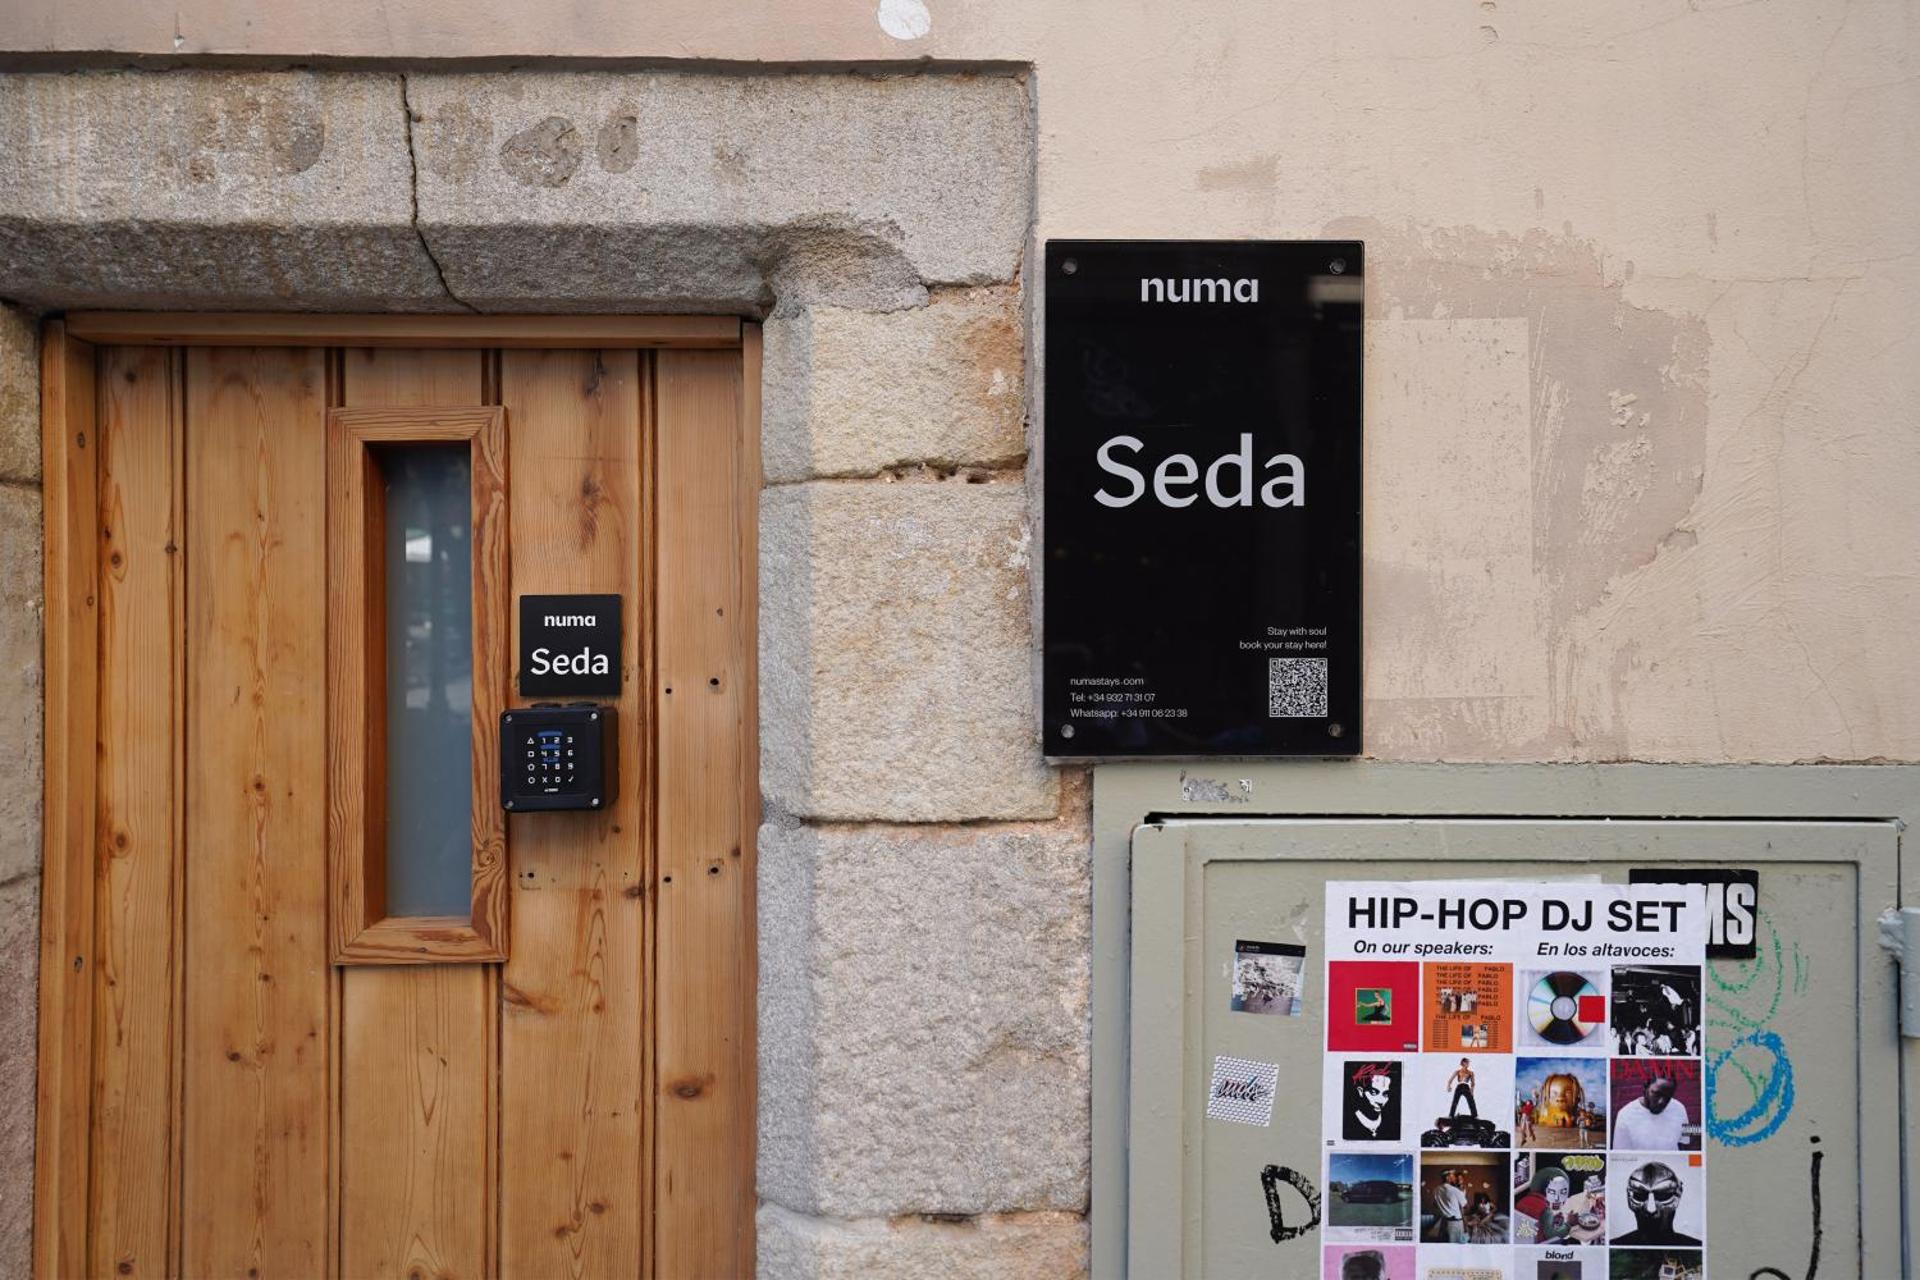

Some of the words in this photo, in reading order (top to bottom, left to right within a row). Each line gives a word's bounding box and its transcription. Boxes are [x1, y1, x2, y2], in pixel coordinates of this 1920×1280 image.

[1141, 278, 1259, 303] numa
[1094, 433, 1305, 508] Seda
[544, 615, 597, 627] numa
[1267, 626, 1288, 637] Stay
[1288, 626, 1307, 636] with
[1308, 626, 1327, 636] soul
[1239, 640, 1261, 649] book
[1263, 641, 1283, 651] your
[1284, 641, 1303, 651] stay
[530, 646, 609, 675] Seda
[1070, 692, 1086, 702] Tel:
[1088, 692, 1105, 702] +34
[1106, 693, 1123, 702] 932
[1121, 709, 1138, 718] +34
[1164, 709, 1176, 718] 23
[1349, 897, 1527, 931] HIP-HOP
[1542, 900, 1593, 932] DJ
[1607, 900, 1687, 932] SET
[1353, 939, 1377, 954] On
[1382, 942, 1411, 954] our
[1413, 941, 1494, 957] speakers:
[1537, 942, 1559, 956] En
[1563, 943, 1588, 956] los
[1592, 943, 1676, 958] altavoces:
[1545, 1251, 1574, 1260] blond
